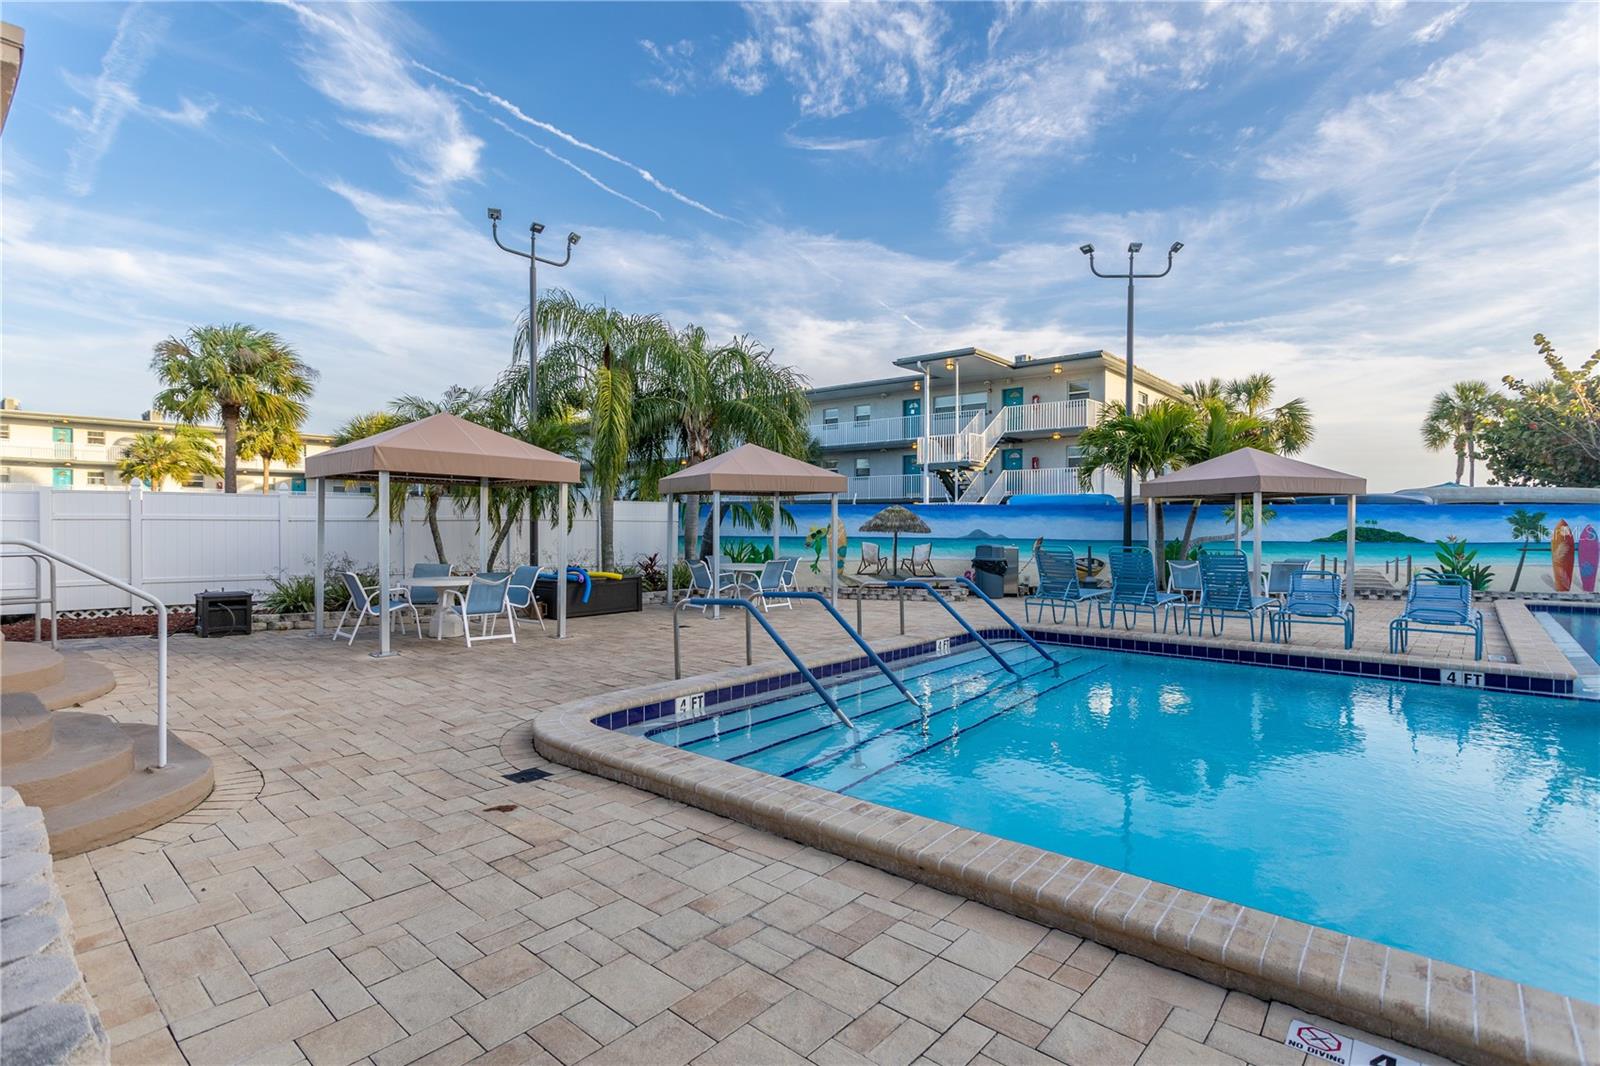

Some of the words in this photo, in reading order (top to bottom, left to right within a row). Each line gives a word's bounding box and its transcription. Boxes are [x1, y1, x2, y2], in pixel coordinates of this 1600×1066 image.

[1446, 671, 1457, 684] 4
[1464, 673, 1482, 685] FT
[679, 698, 687, 713] 4
[691, 695, 704, 710] FT
[1288, 1039, 1303, 1049] NO
[1307, 1046, 1345, 1065] DIVING
